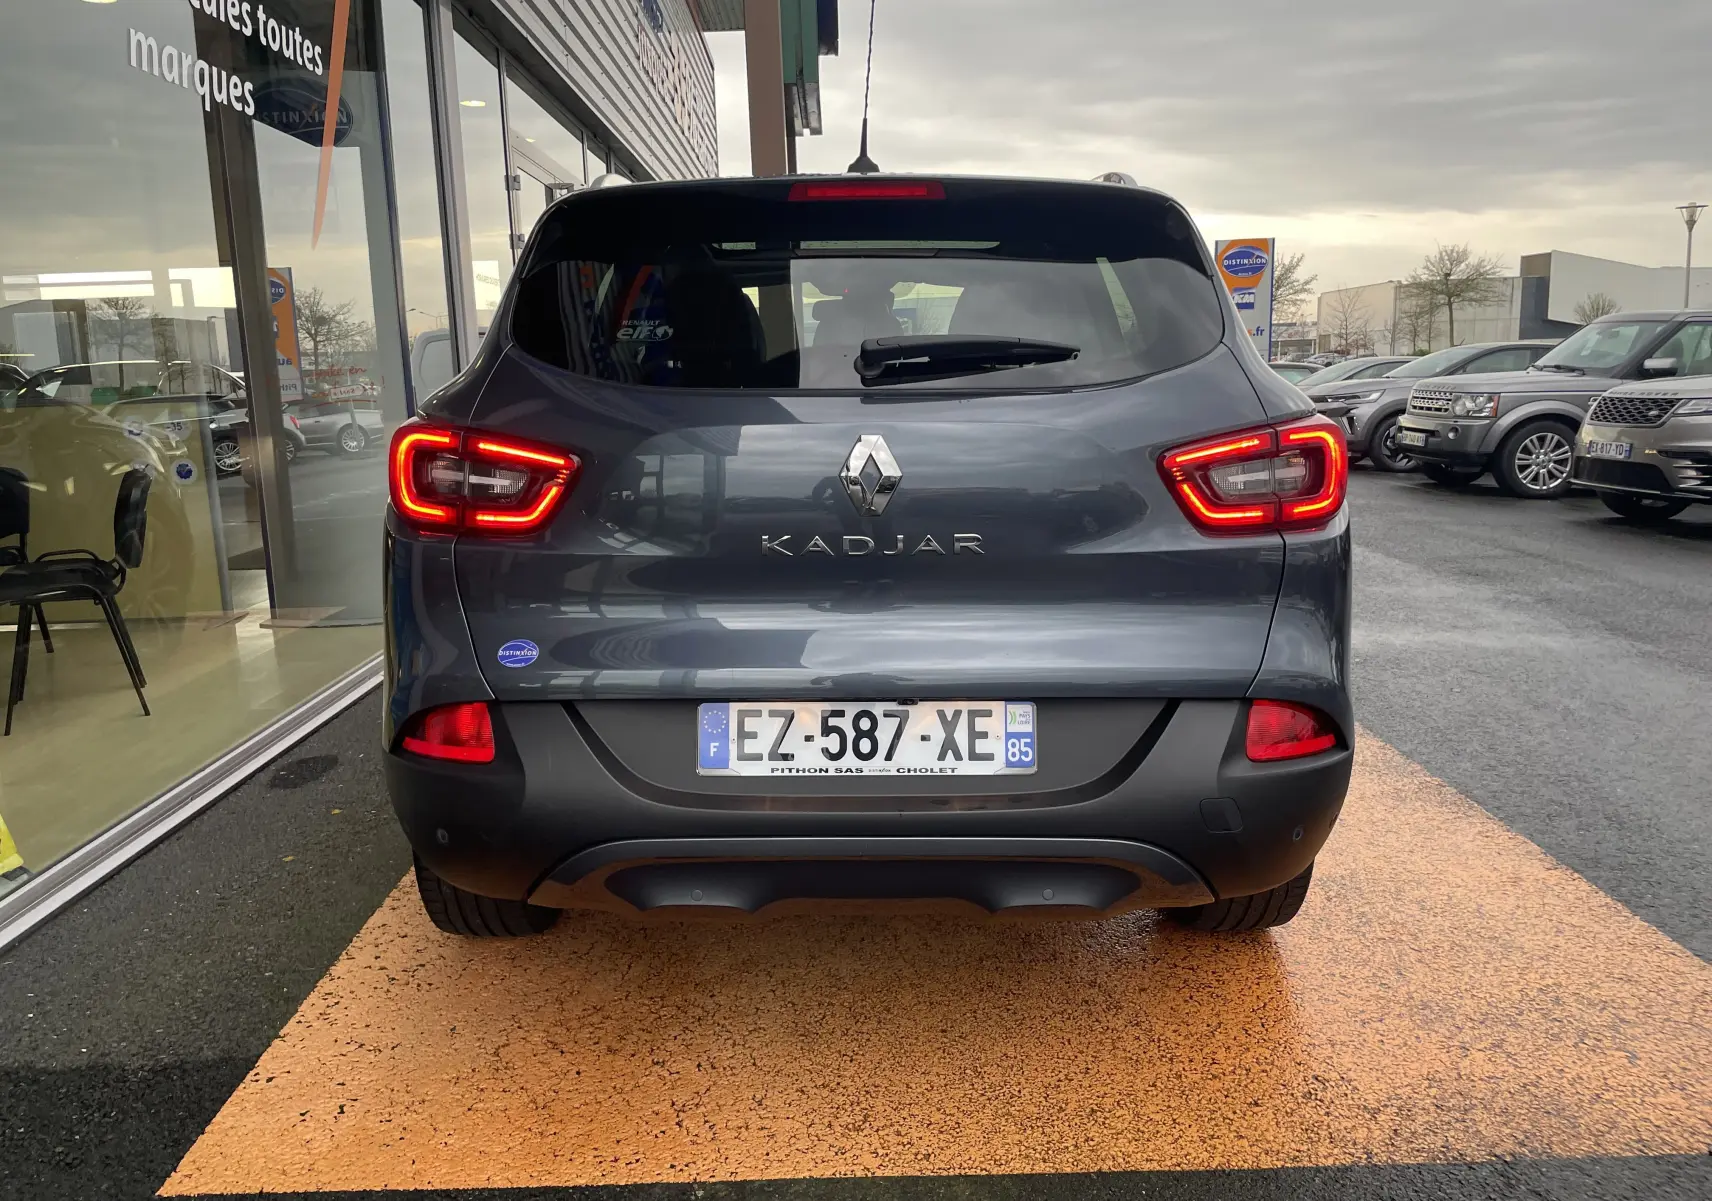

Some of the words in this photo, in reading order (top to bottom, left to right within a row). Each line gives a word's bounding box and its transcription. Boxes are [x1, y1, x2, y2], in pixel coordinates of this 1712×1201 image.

[256, 4, 323, 76] toutes
[129, 27, 255, 116] marques
[1223, 258, 1266, 266] DISTINXION
[761, 533, 985, 556] KADJAR
[710, 743, 719, 757] F
[1007, 738, 1033, 762] 85
